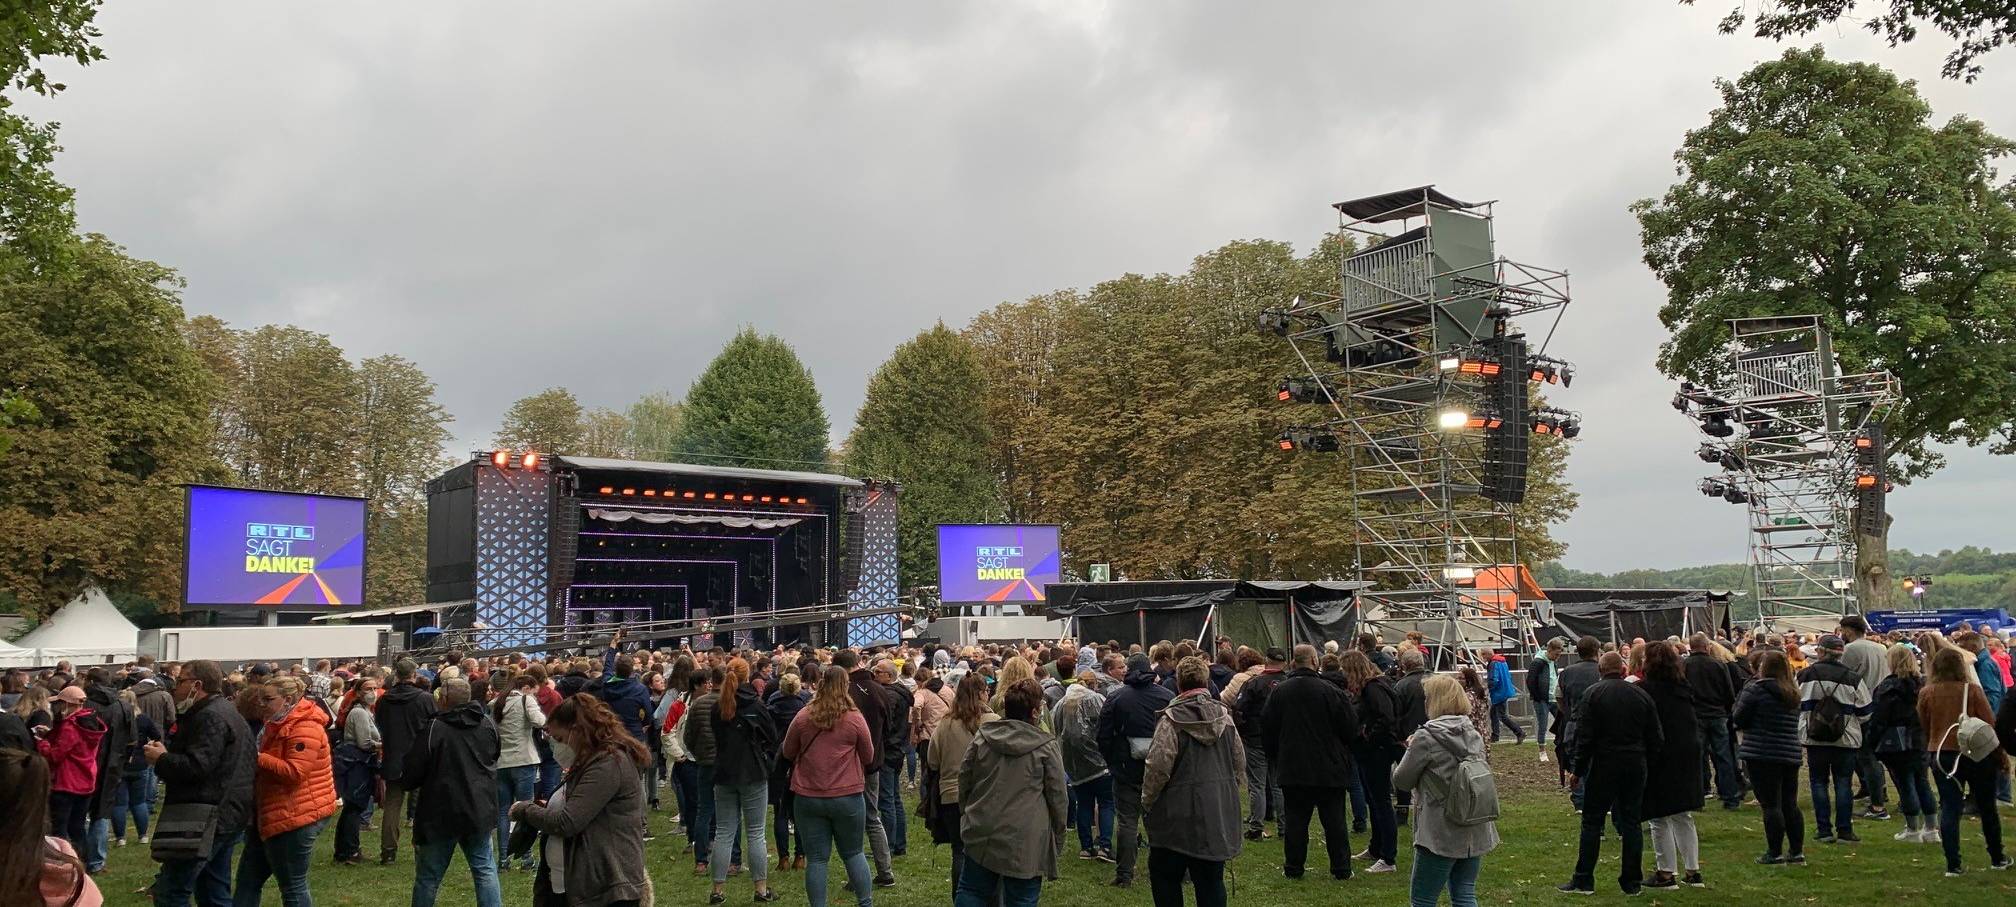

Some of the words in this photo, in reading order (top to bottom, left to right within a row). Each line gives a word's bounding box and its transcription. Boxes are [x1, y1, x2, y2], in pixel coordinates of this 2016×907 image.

[248, 524, 313, 539] RTL
[246, 538, 293, 556] SAGT
[978, 547, 1021, 556] RTL
[246, 556, 314, 574] DANKE!
[977, 556, 1008, 569] SAGT
[977, 568, 1024, 580] DANKE!
